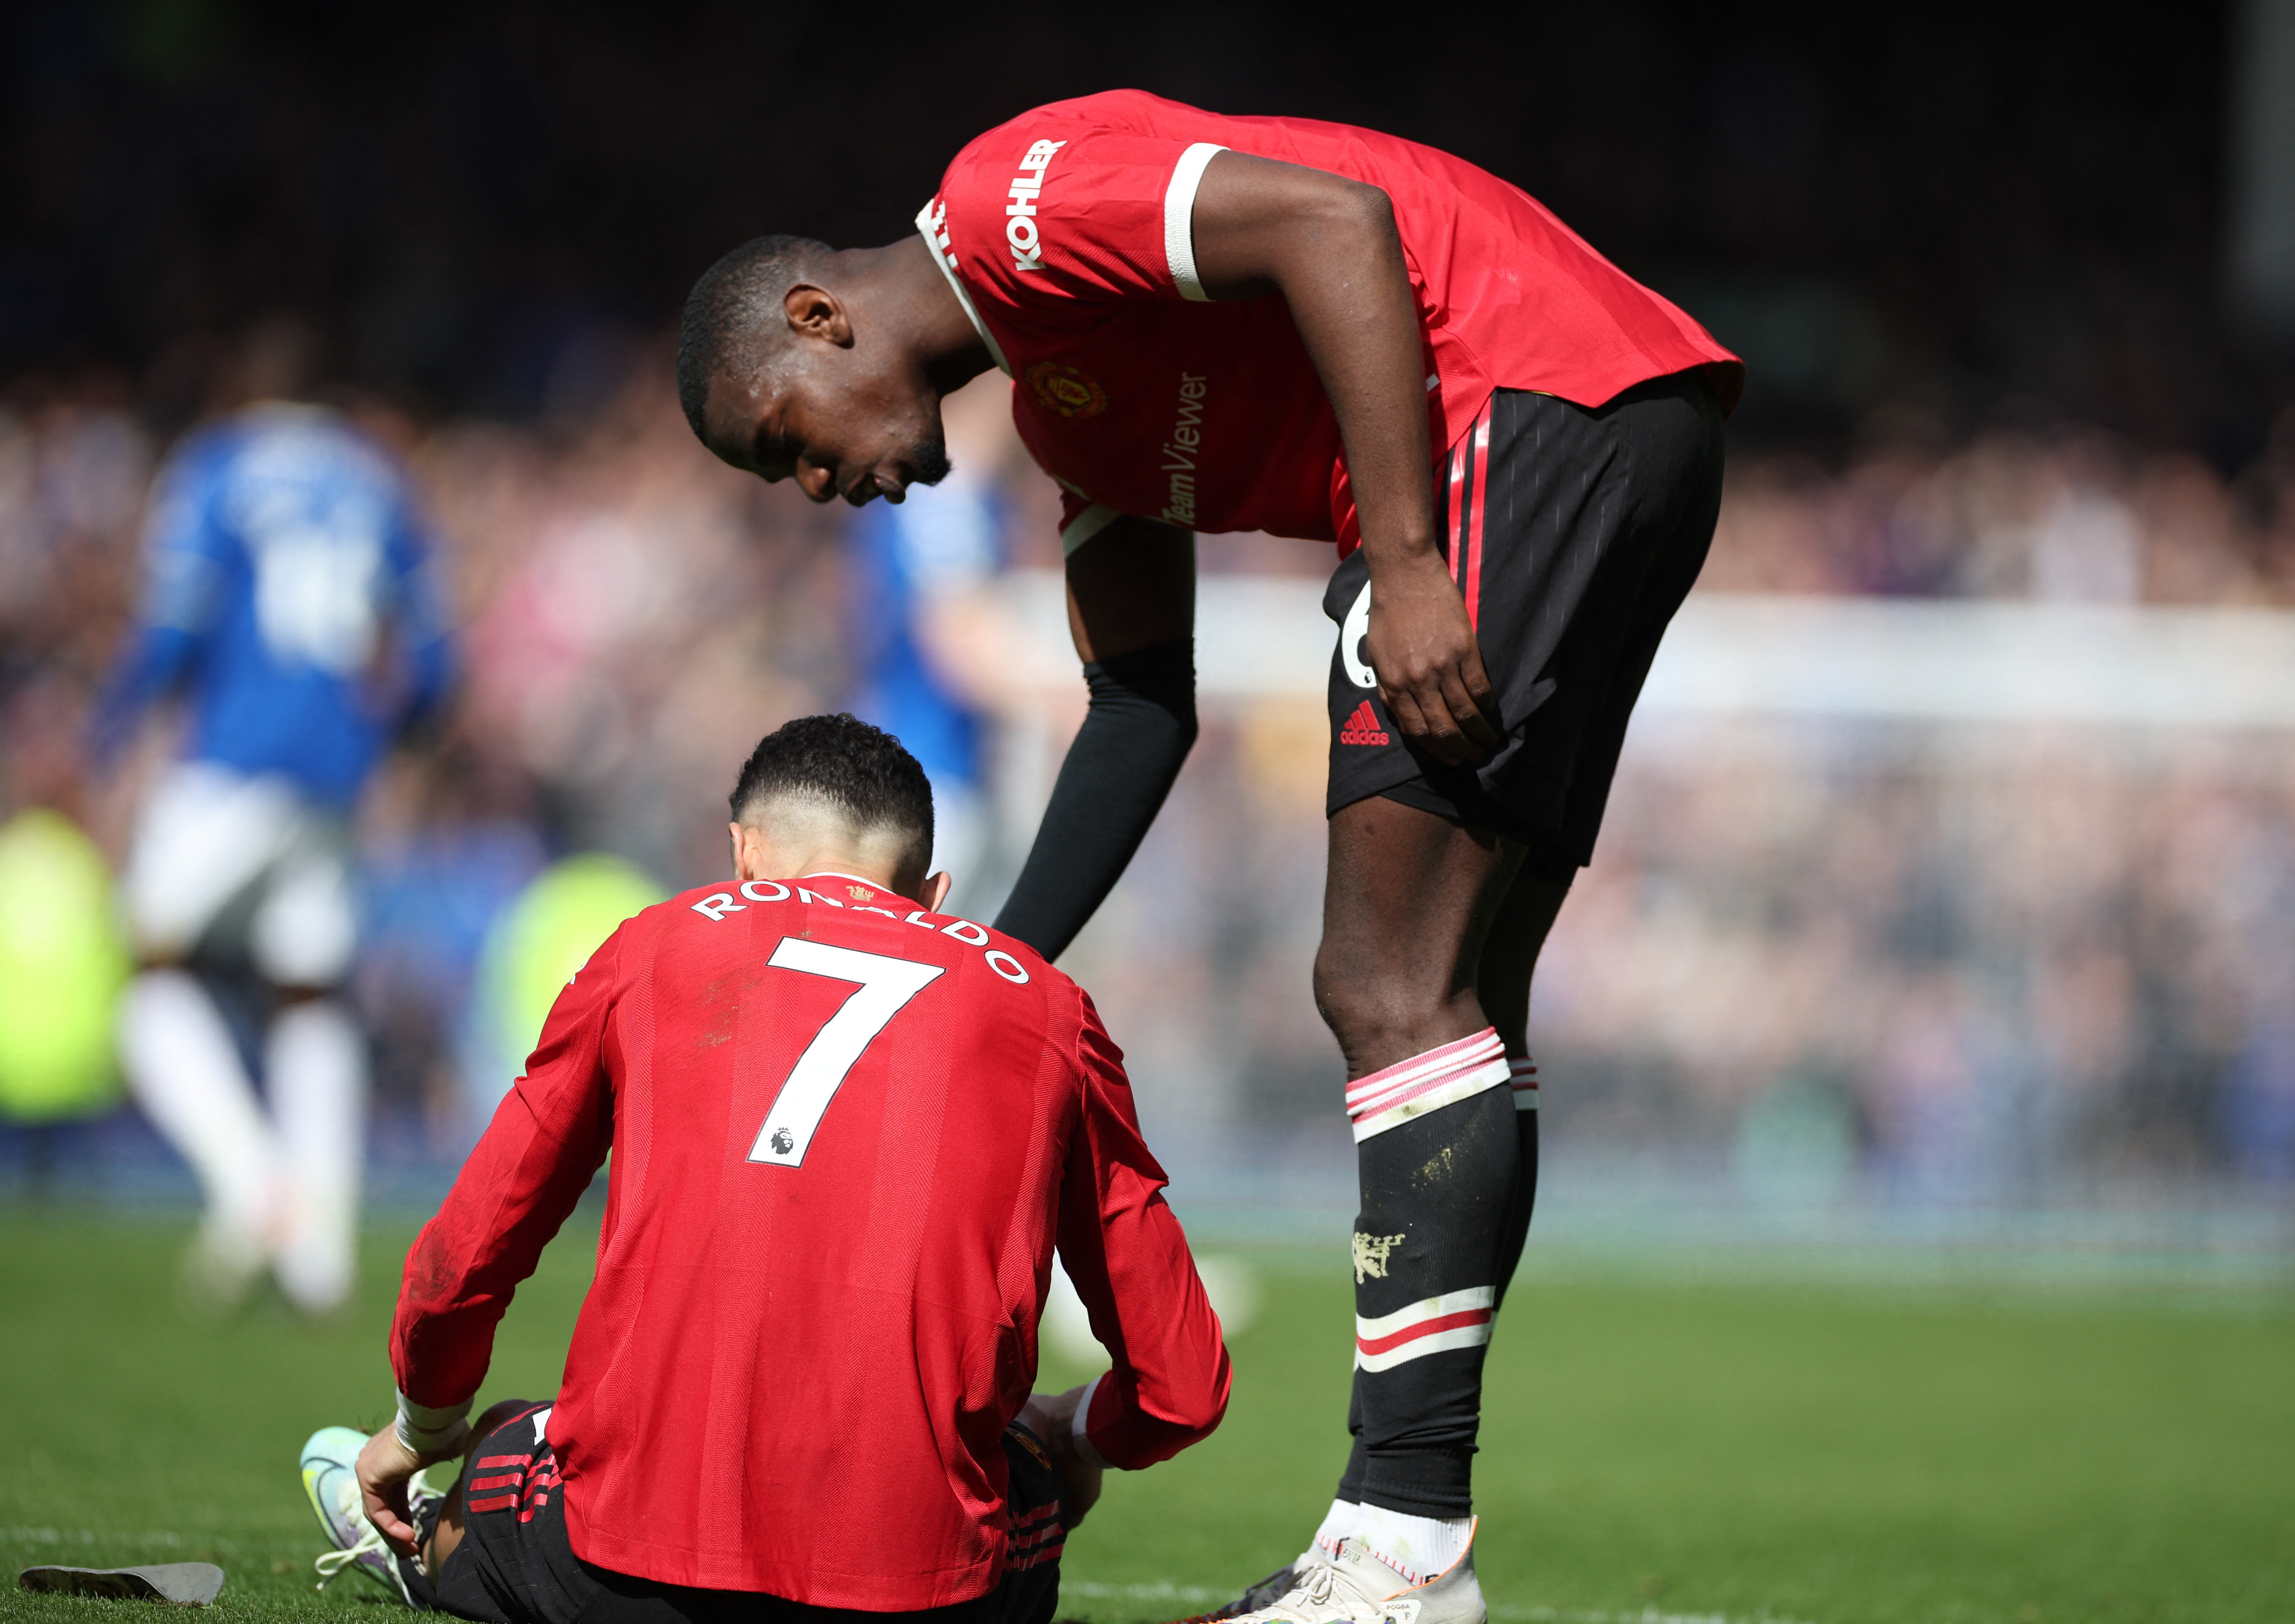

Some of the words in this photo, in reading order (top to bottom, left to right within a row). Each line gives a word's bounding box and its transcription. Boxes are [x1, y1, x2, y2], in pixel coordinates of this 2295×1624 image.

[1006, 139, 1067, 271] KOHLER
[1161, 372, 1207, 525] TeamViewer
[1340, 729, 1389, 746] adidas
[746, 936, 947, 1169] 7
